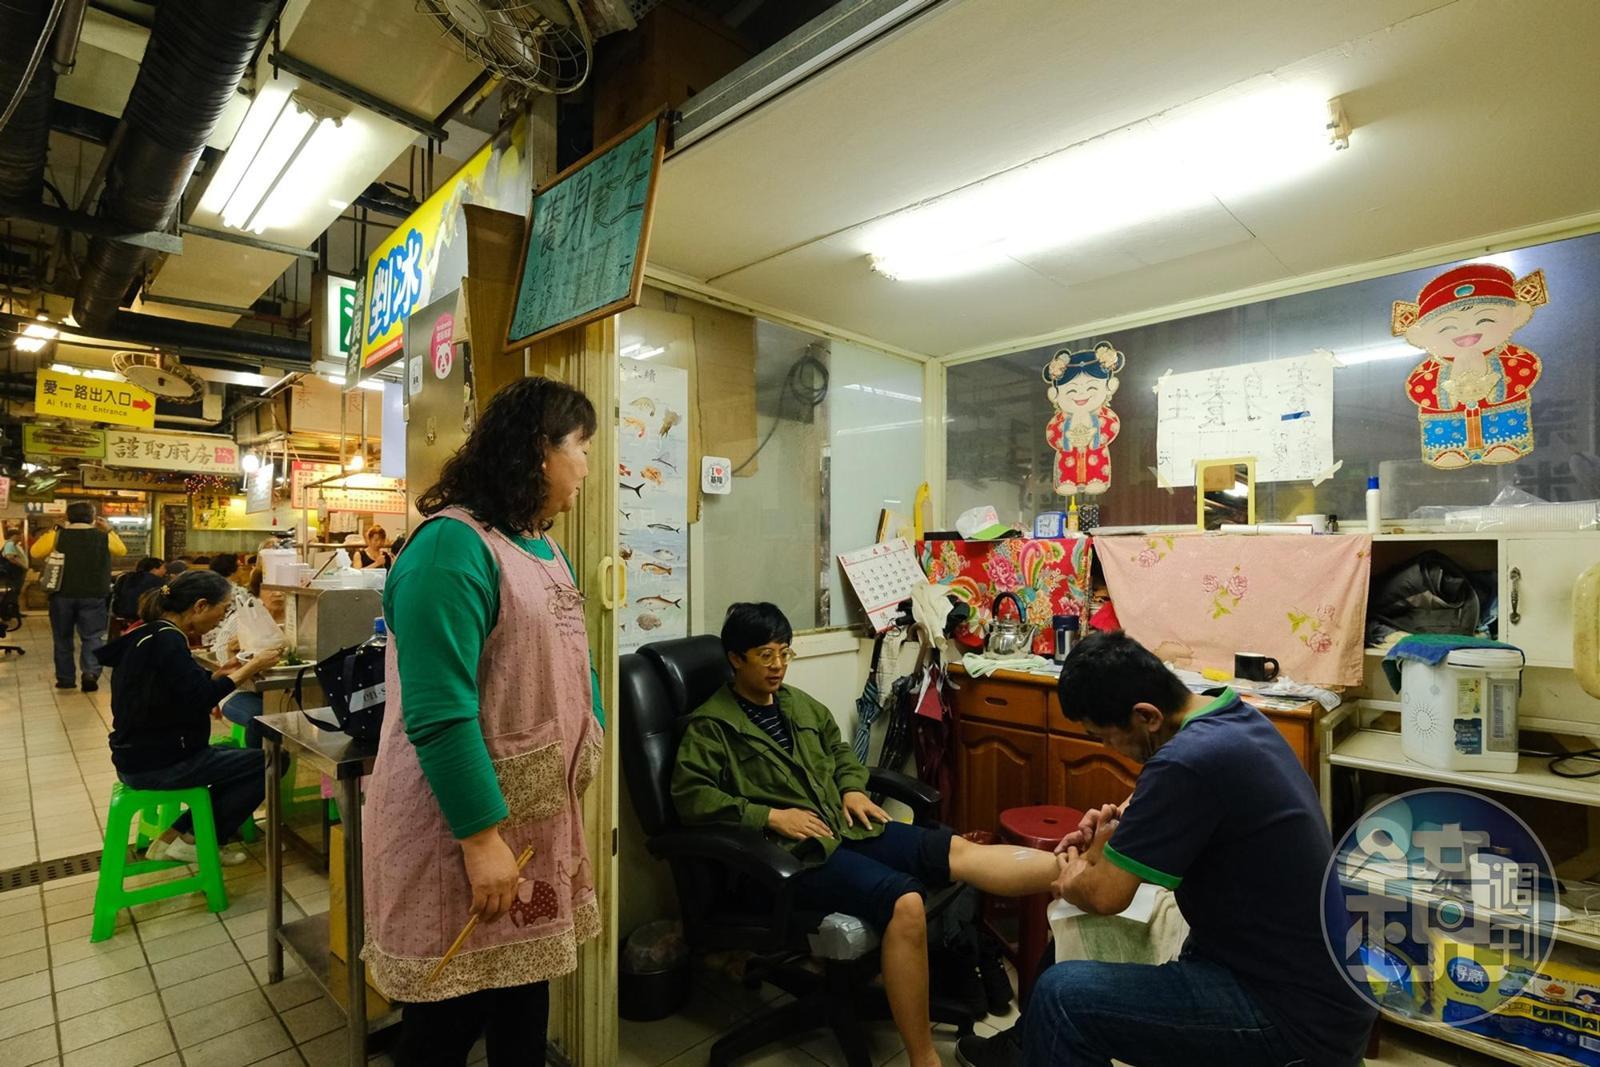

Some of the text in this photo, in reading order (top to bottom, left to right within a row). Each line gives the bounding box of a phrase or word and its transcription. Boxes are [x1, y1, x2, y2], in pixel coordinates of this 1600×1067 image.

[368, 232, 422, 344] 剉冰
[43, 379, 131, 407] 愛一路出入口
[92, 405, 128, 416] Entrance
